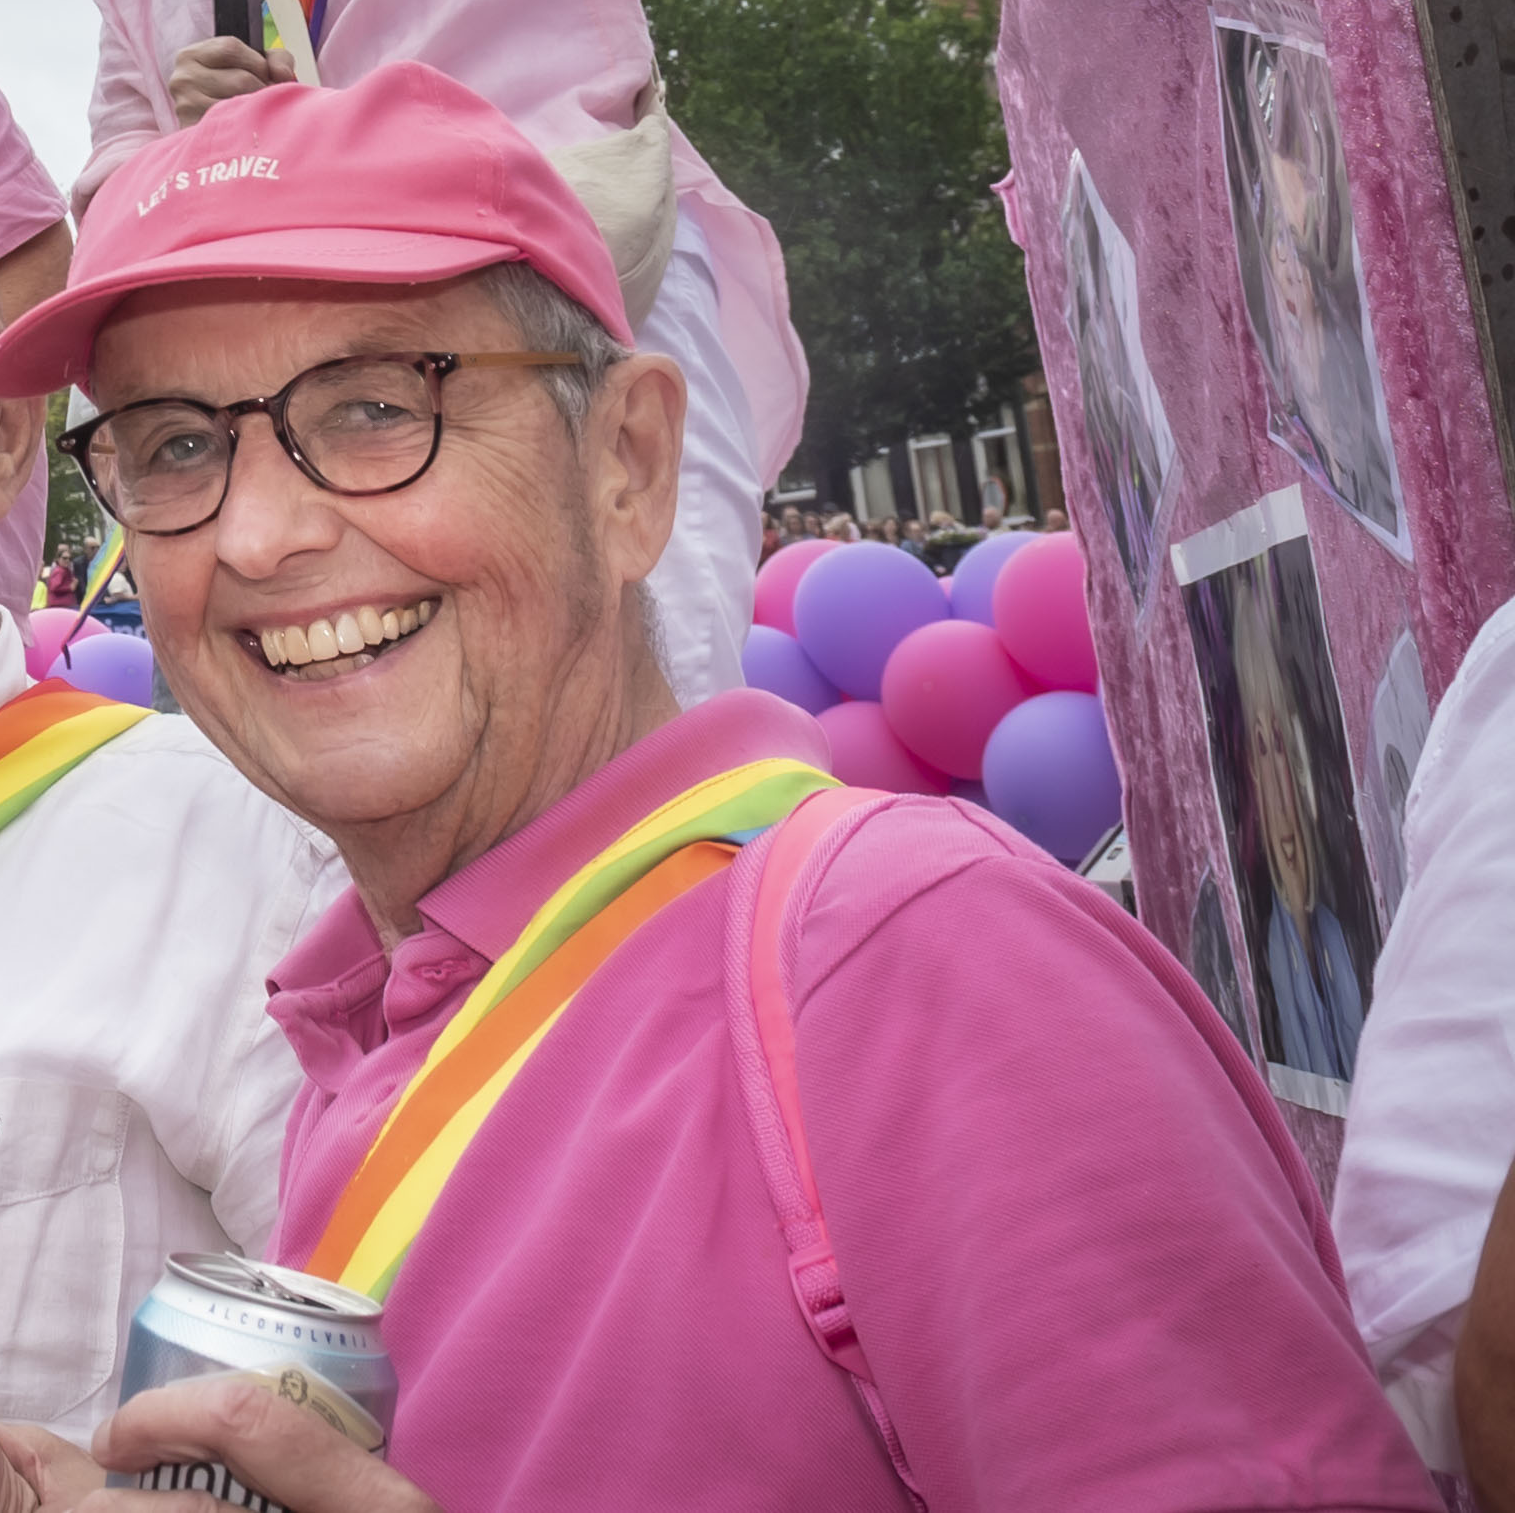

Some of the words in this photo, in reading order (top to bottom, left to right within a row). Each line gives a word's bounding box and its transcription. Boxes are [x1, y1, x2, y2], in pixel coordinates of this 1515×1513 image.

[136, 171, 190, 218] LET'S
[196, 155, 280, 186] TRAVEL
[208, 1302, 368, 1349] ALCOHOLVRIJ
